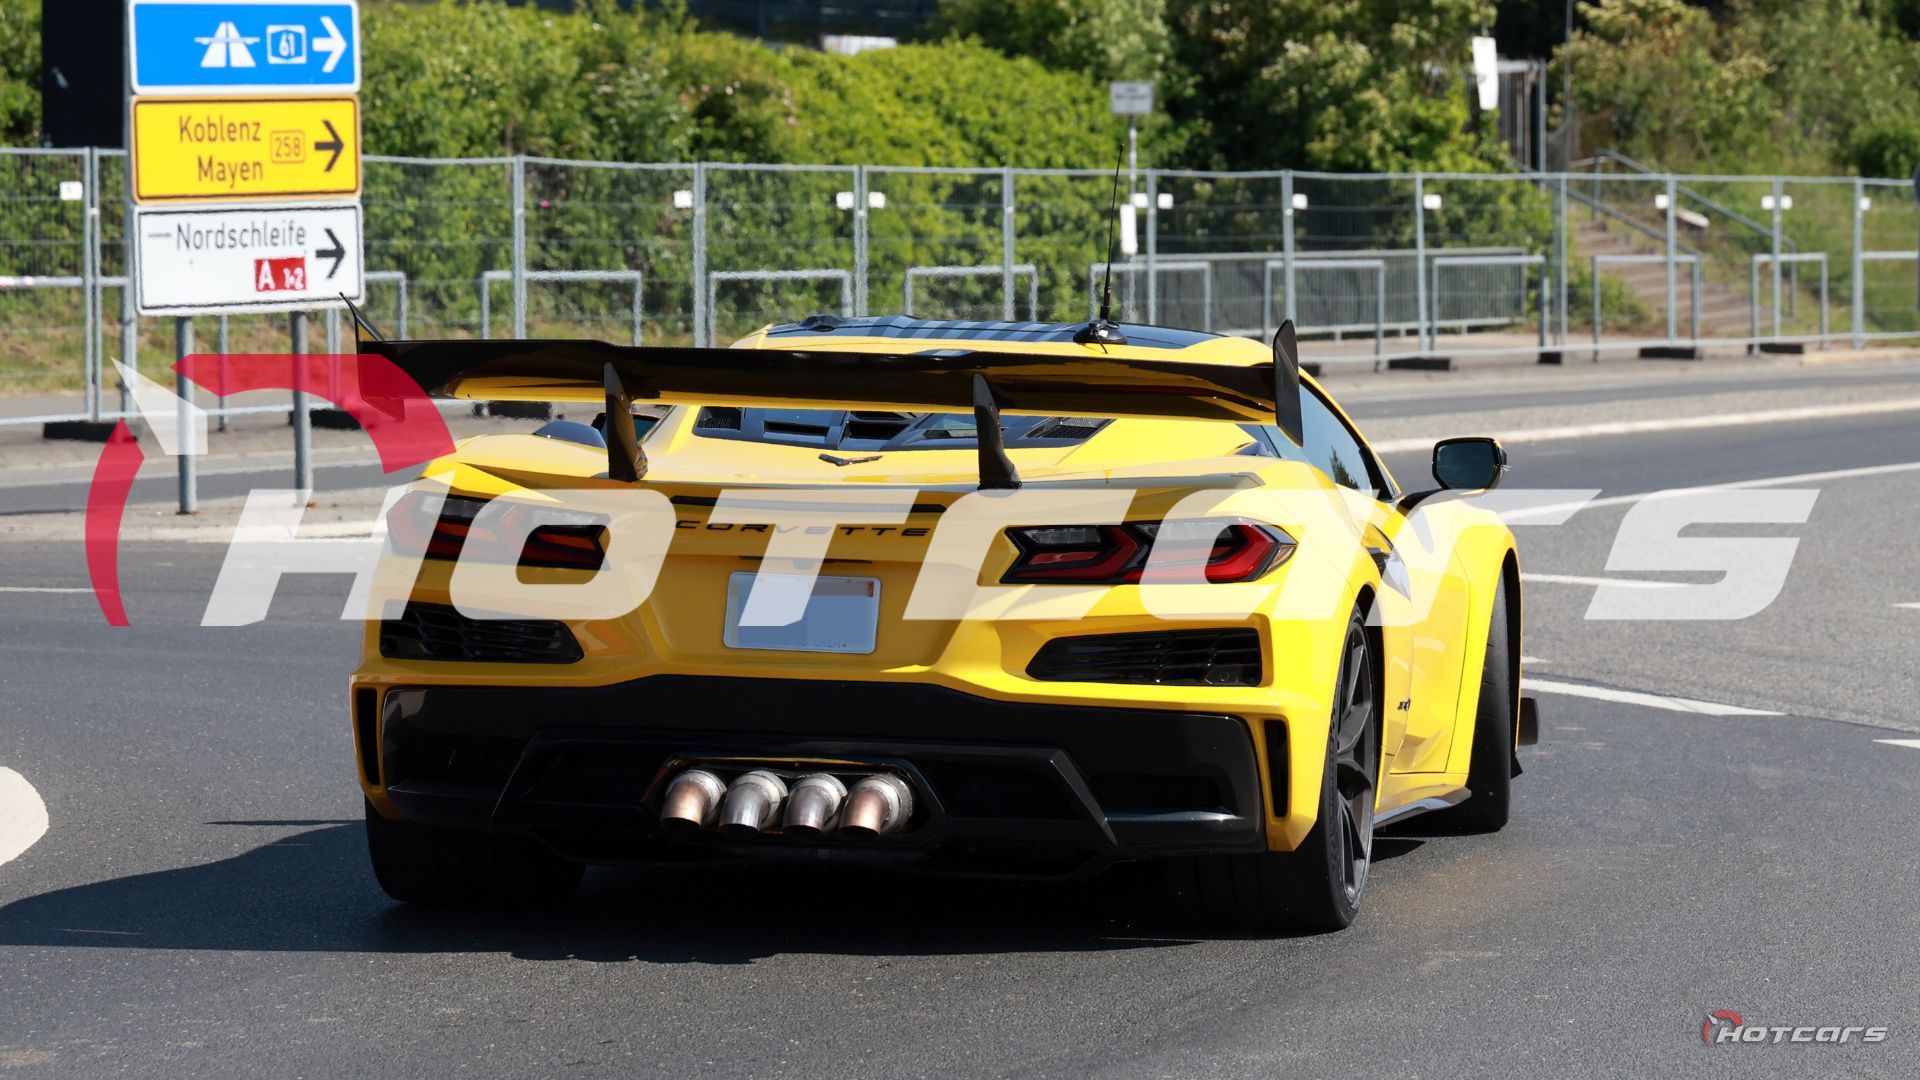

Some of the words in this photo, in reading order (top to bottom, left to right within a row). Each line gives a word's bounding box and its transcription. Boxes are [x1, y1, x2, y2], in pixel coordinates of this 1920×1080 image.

[279, 32, 295, 57] 61
[179, 115, 261, 143] Koblenz
[274, 136, 301, 158] 258
[197, 155, 264, 189] Mayen
[176, 219, 306, 251] Nordschleife
[258, 260, 276, 290] A
[675, 519, 931, 537] CORVETTE
